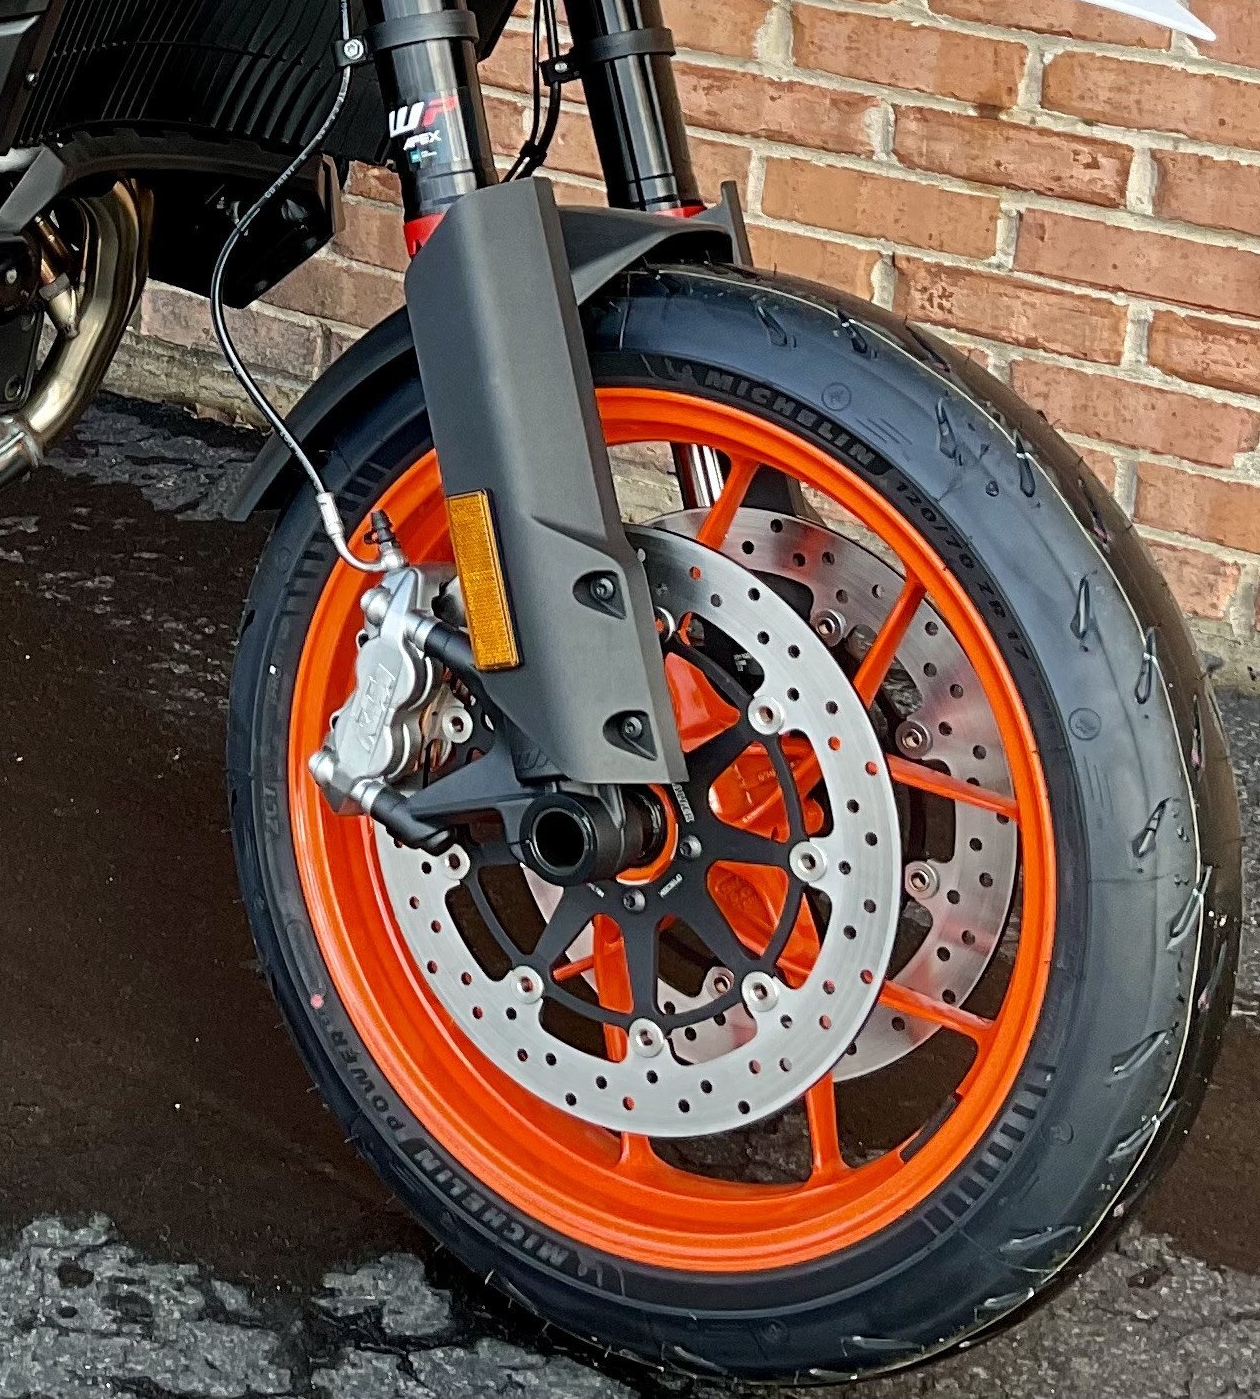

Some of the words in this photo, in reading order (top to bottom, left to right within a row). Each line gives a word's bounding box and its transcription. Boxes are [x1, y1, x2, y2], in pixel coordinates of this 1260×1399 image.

[704, 368, 876, 466] MICHELIN
[329, 1030, 406, 1130] POWER
[414, 1148, 570, 1266] MICHELIN
